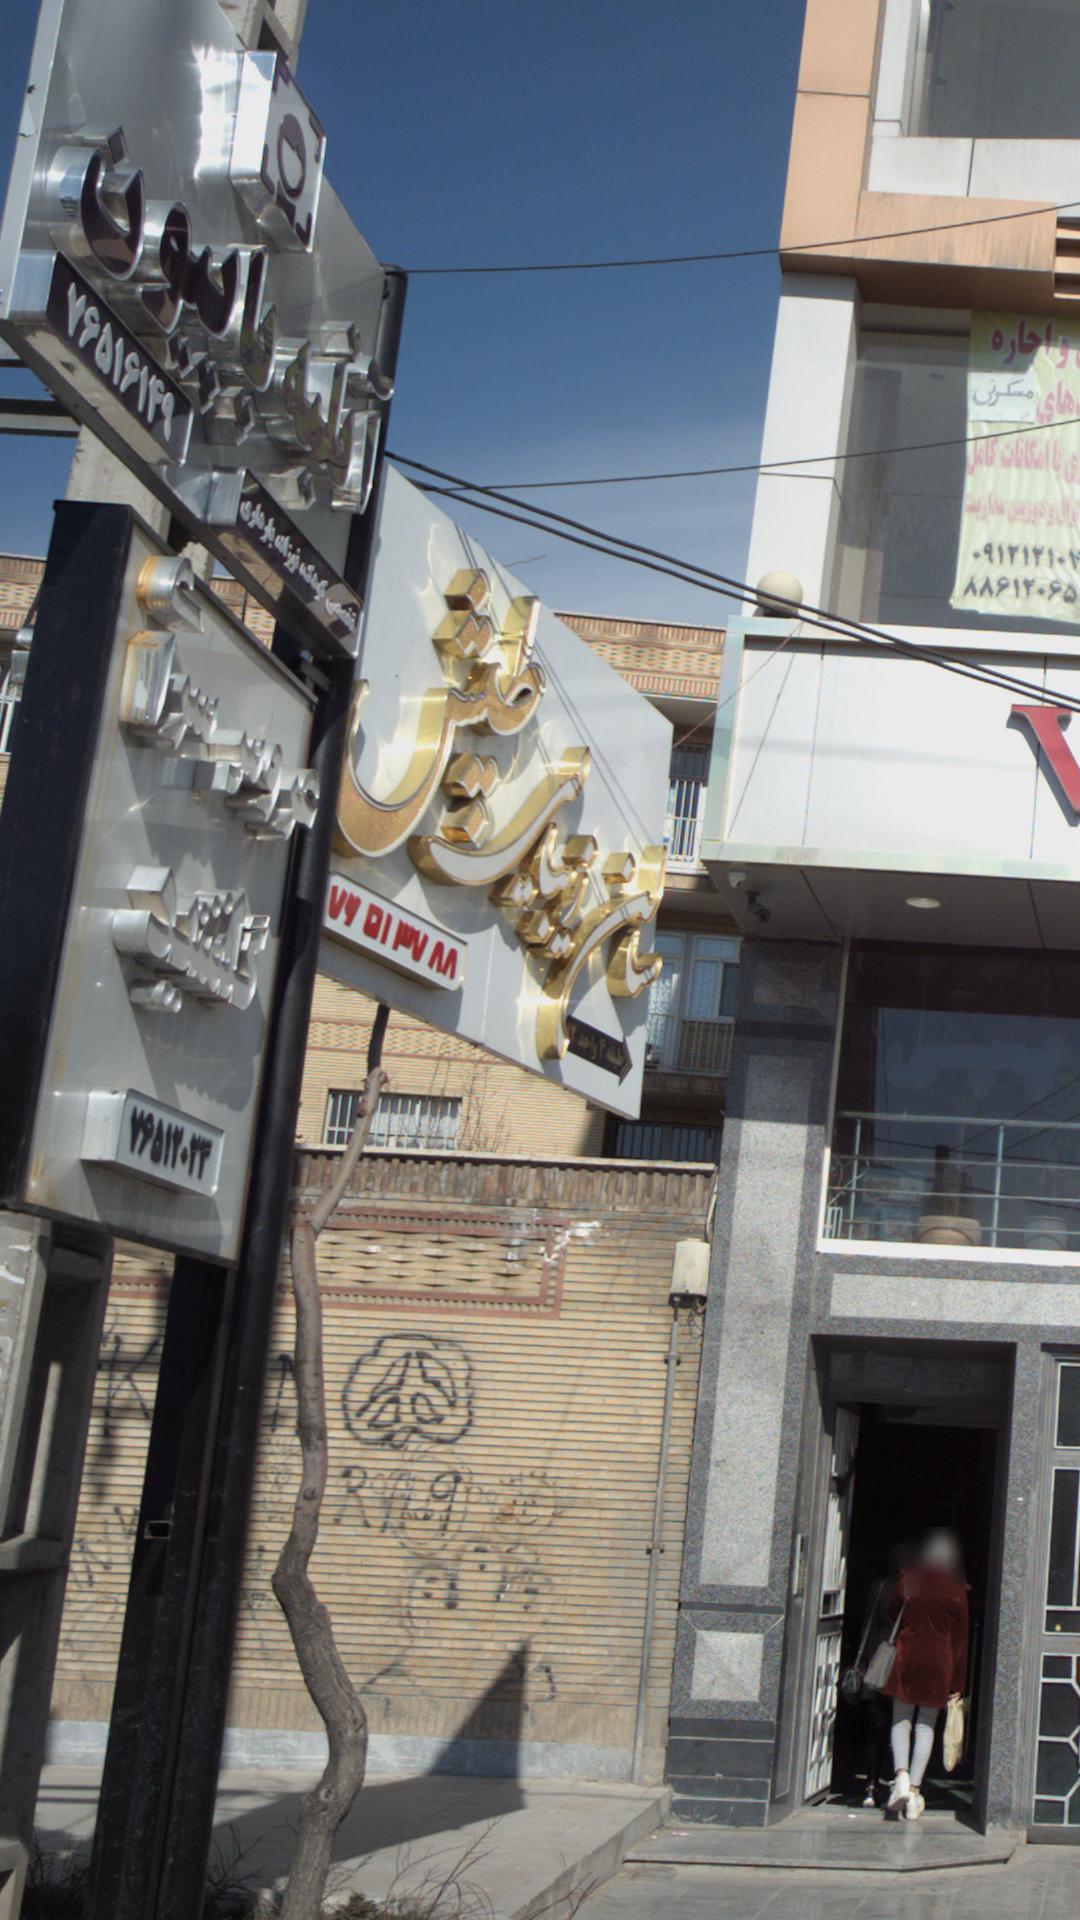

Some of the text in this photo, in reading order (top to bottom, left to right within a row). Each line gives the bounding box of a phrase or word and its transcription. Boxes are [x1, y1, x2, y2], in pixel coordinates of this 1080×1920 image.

[67, 282, 175, 442] ۷۶۵۱۶۱۴۹
[991, 319, 1053, 365] اجاره
[973, 379, 1034, 406] مسکونی
